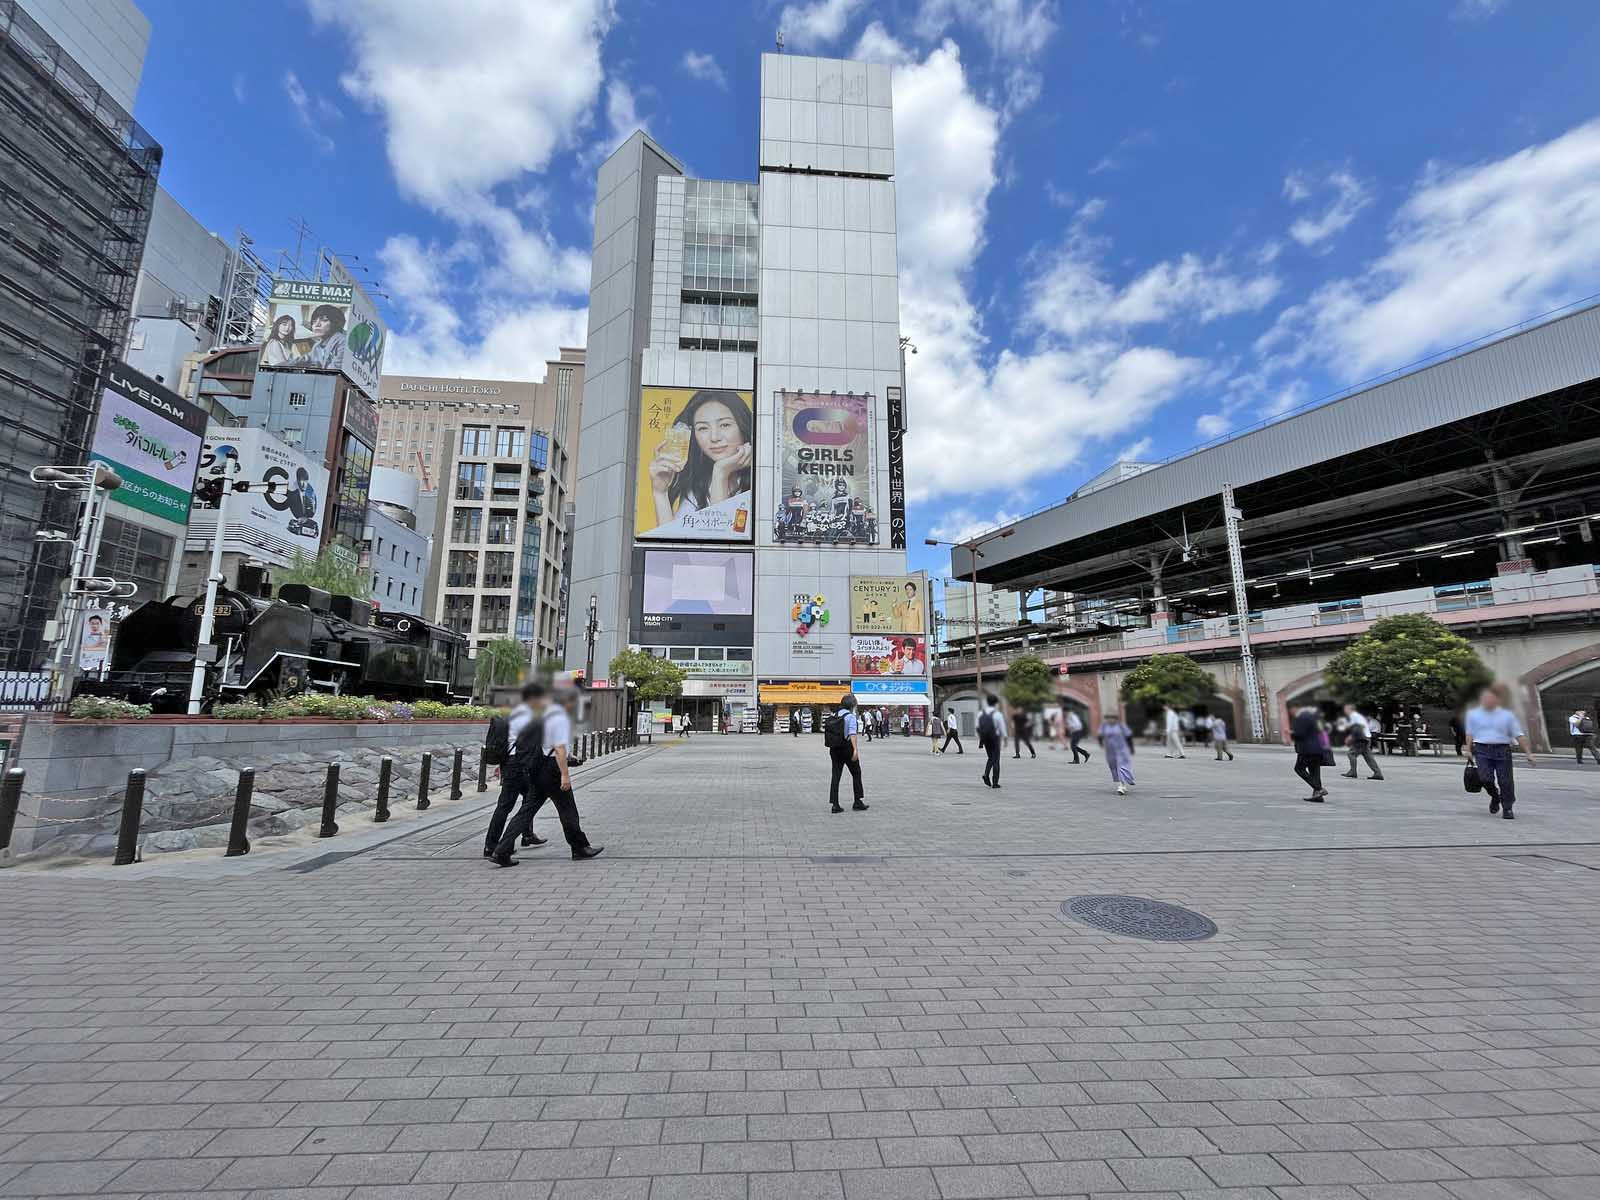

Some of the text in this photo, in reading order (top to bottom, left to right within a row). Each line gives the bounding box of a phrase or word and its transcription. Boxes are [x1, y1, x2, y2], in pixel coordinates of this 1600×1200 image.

[322, 286, 352, 298] MAX
[441, 384, 471, 393] HOTEL
[472, 385, 500, 395] TOKYO
[797, 448, 854, 462] GIRLS
[798, 462, 855, 476] KEIRIN
[853, 585, 892, 593] CENTURY
